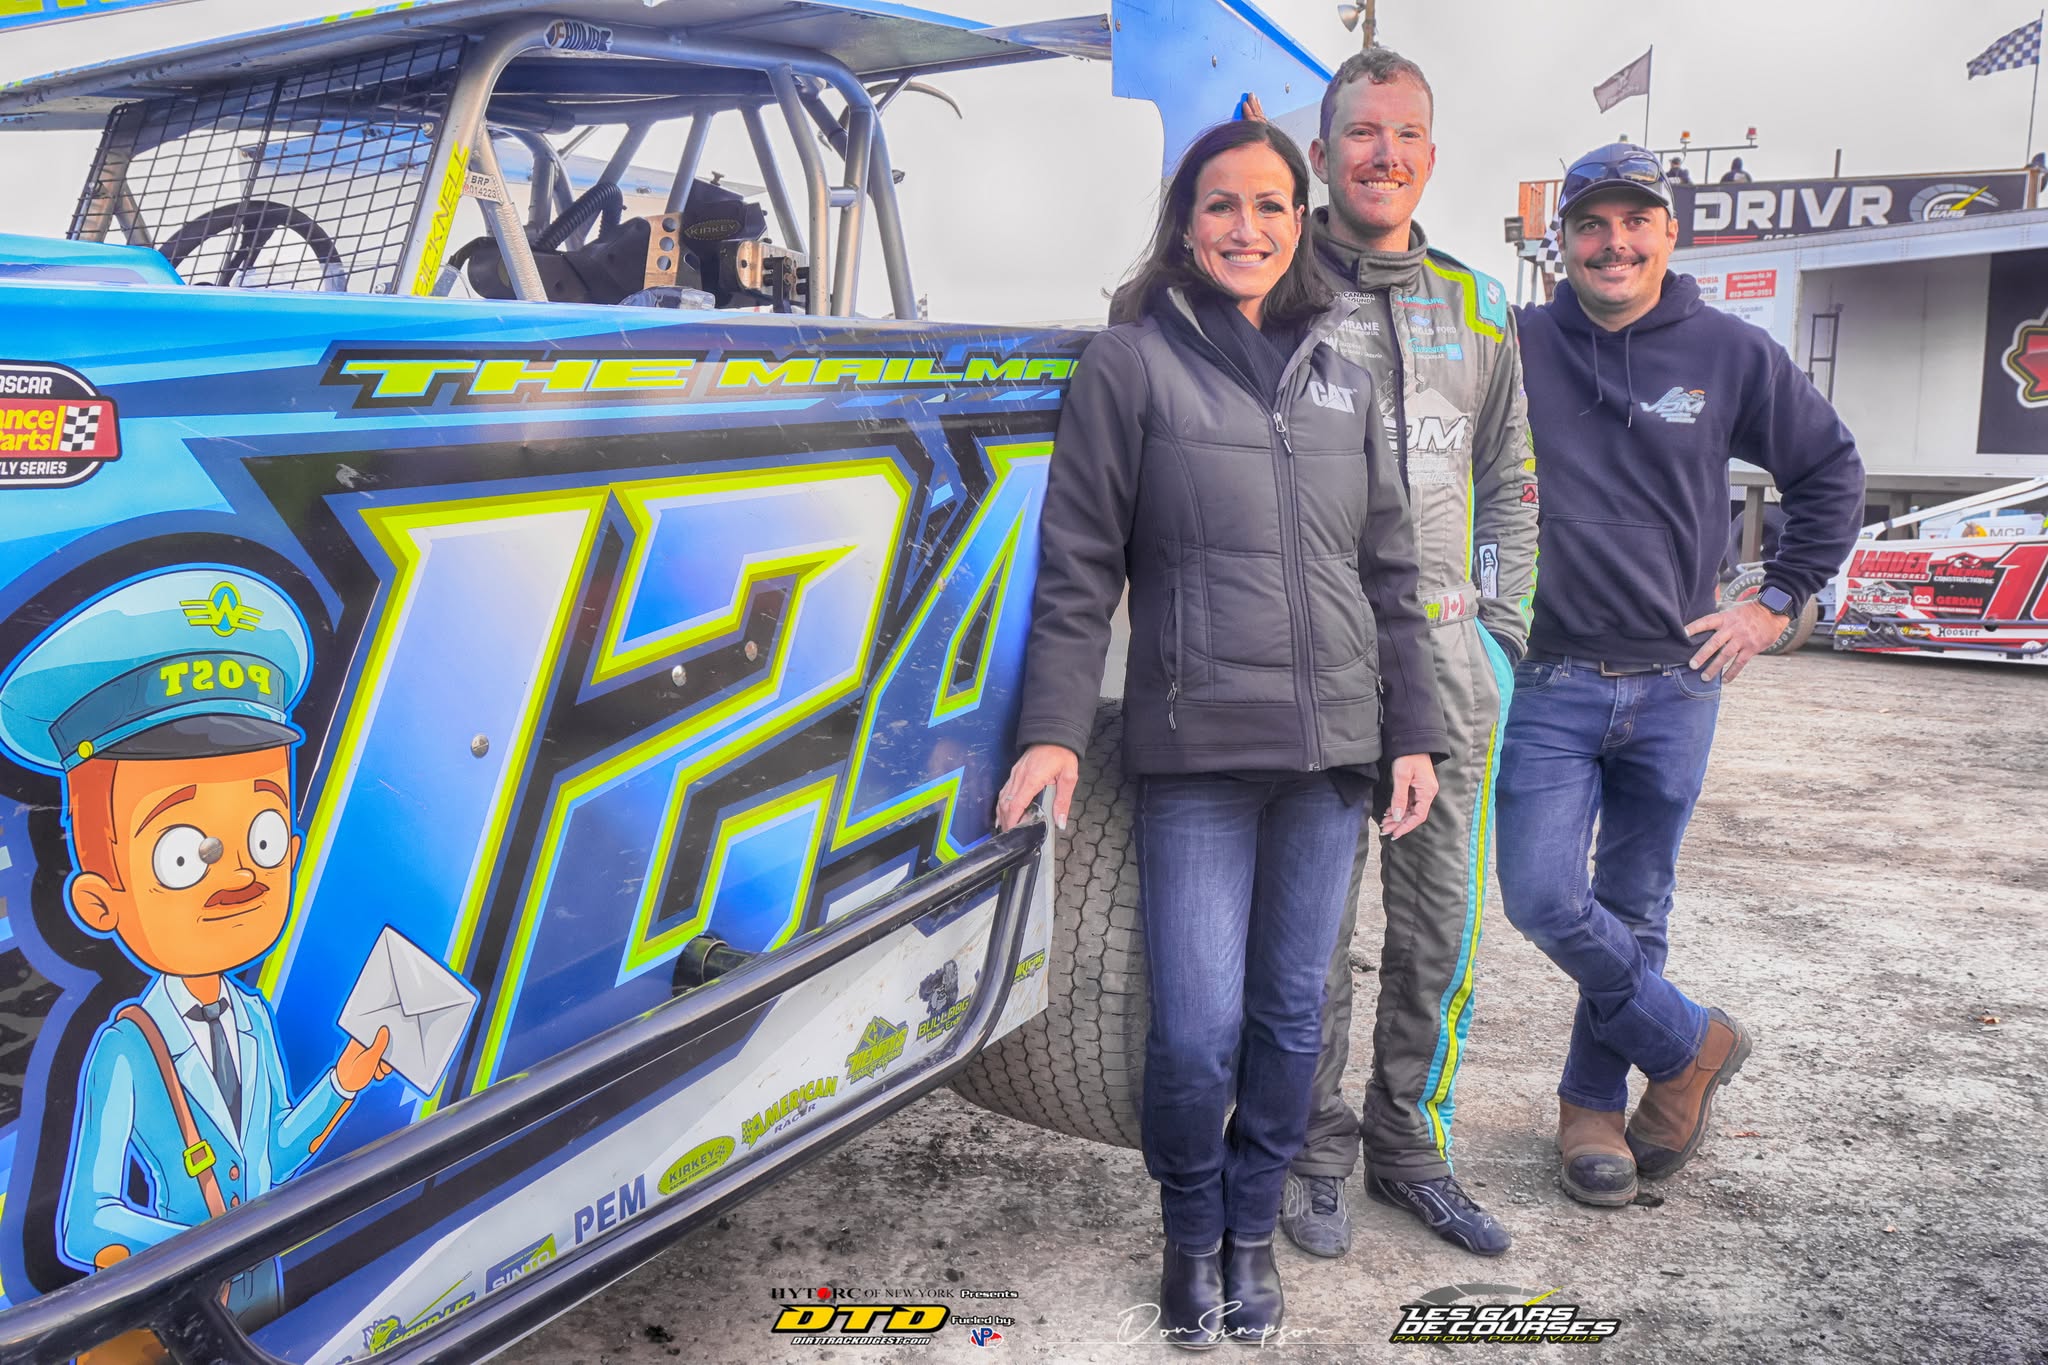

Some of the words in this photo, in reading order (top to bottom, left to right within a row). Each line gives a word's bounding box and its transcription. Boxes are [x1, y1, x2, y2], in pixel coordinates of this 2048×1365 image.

[471, 175, 490, 186] BRP
[1693, 184, 1893, 231] DRIVR
[690, 224, 737, 235] KIRKEY
[340, 359, 696, 398] THE
[716, 357, 1080, 389] MAILMA
[1309, 381, 1355, 414] CAT
[19, 461, 67, 475] SERIES
[1864, 571, 1927, 579] EARTHWORKS
[1936, 595, 1984, 606] GERDAU
[917, 997, 971, 1038] BULLDOG
[748, 1075, 839, 1149] AMERICAN
[774, 1103, 817, 1134] RACR
[668, 1148, 715, 1184] KIRKEY
[574, 1174, 647, 1246] PEM
